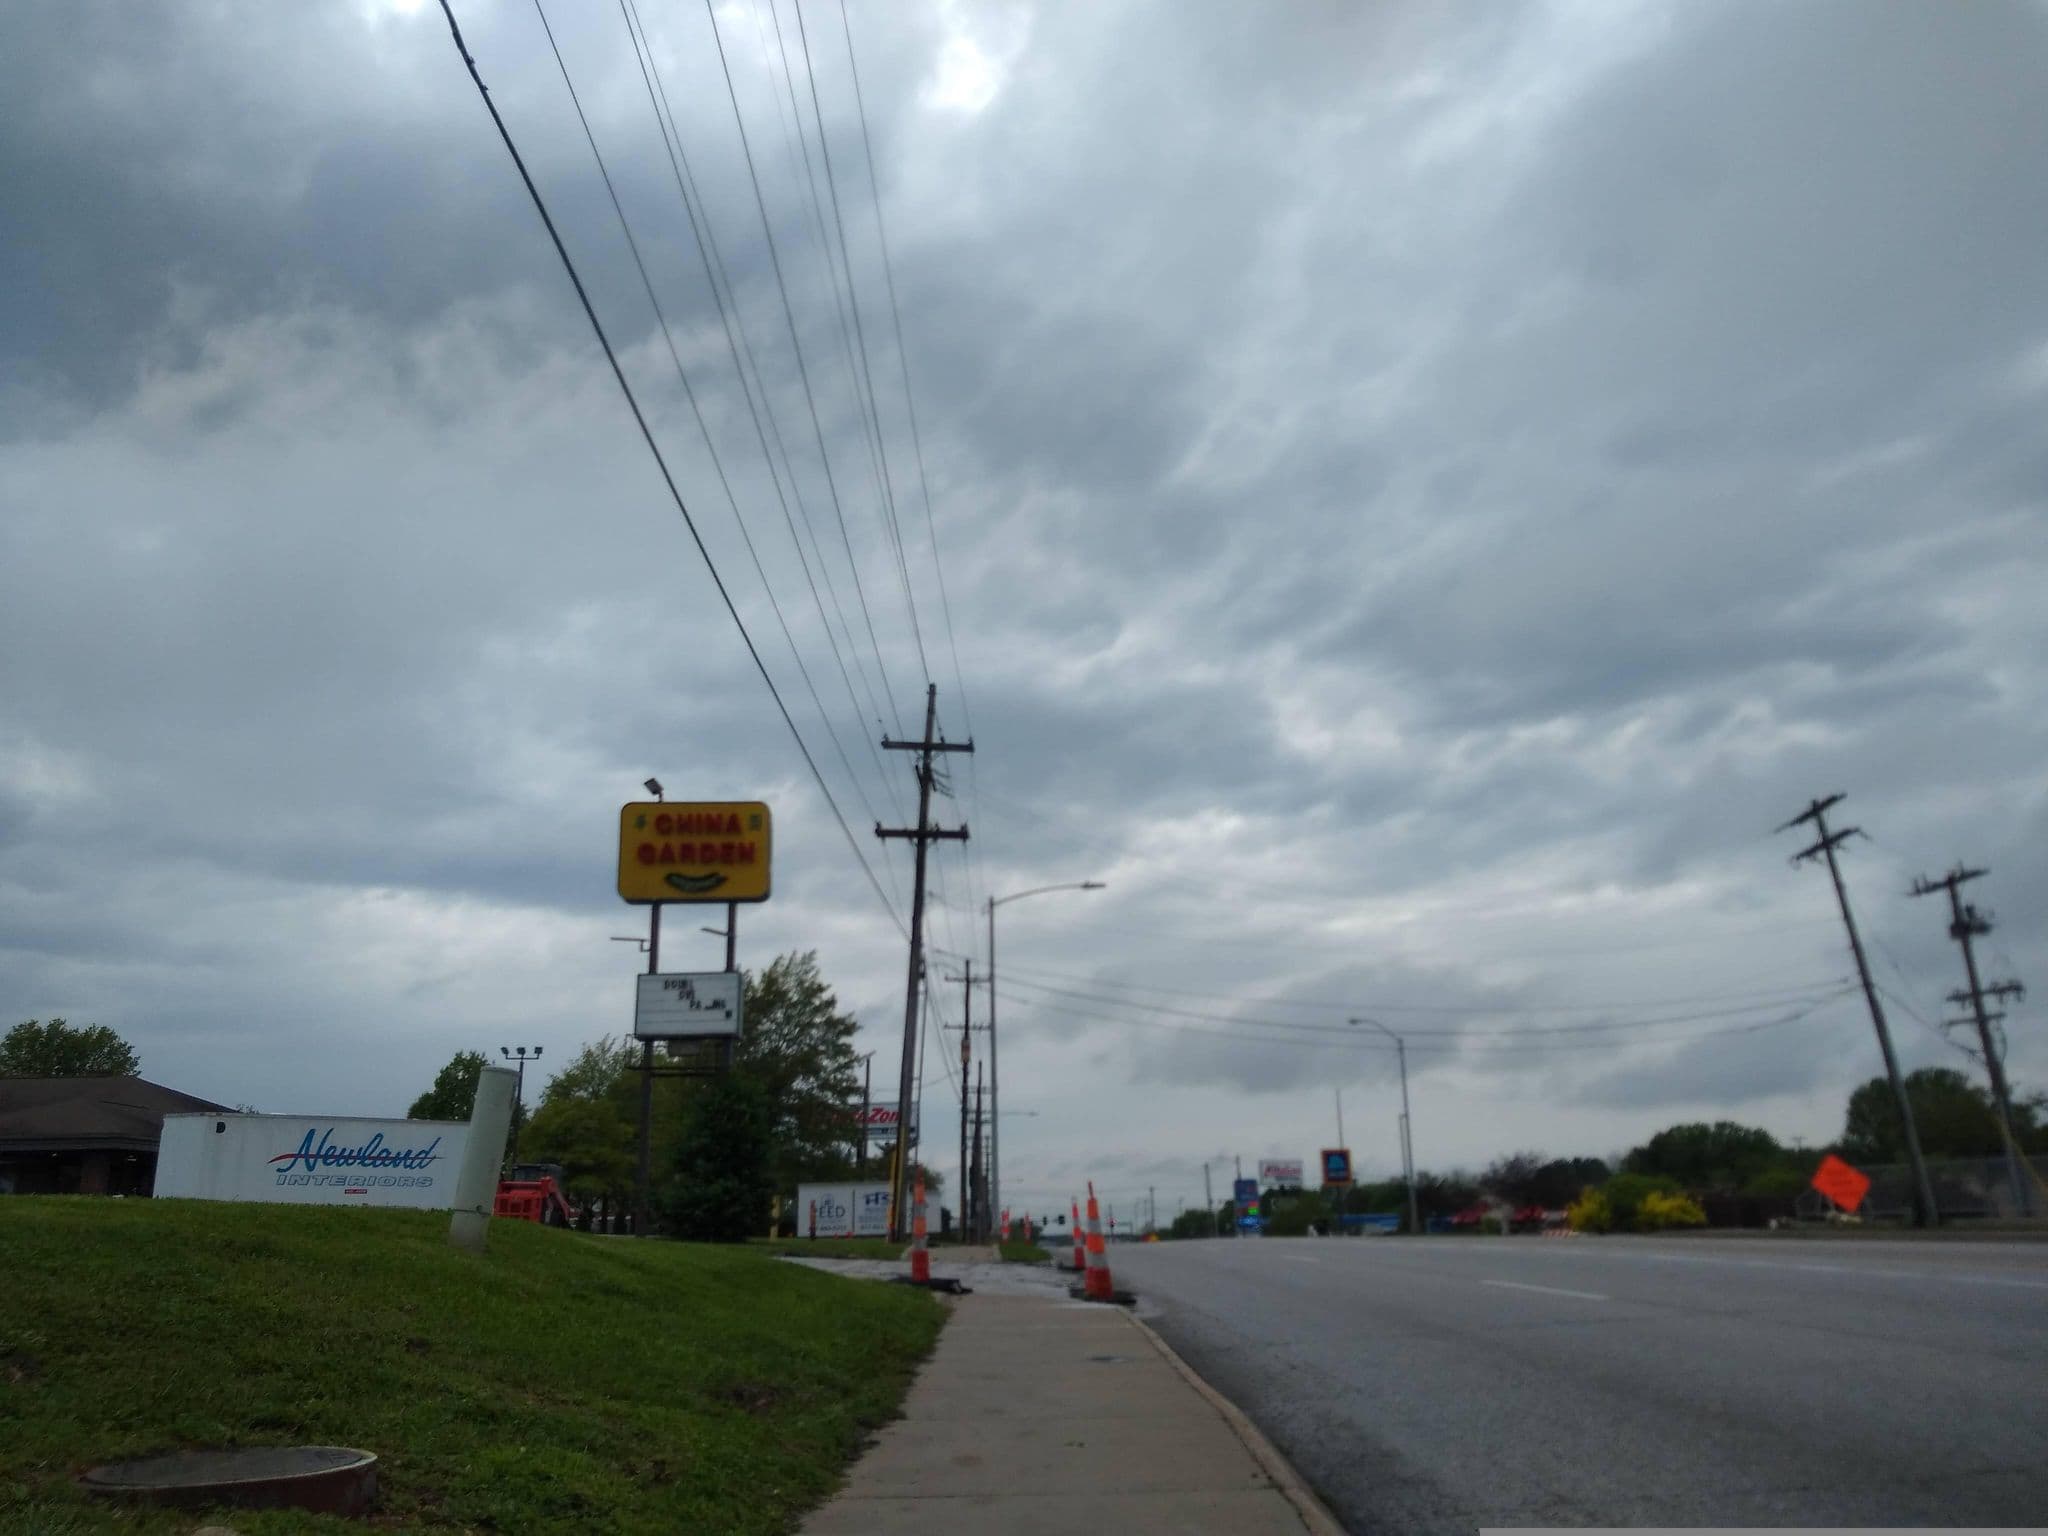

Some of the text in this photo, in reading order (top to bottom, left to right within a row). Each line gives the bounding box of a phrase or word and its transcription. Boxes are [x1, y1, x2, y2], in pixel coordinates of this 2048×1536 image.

[655, 812, 742, 835] CHINA
[637, 842, 756, 866] GARDEN
[276, 1127, 442, 1173] Newland
[276, 1174, 434, 1188] INTERIORS
